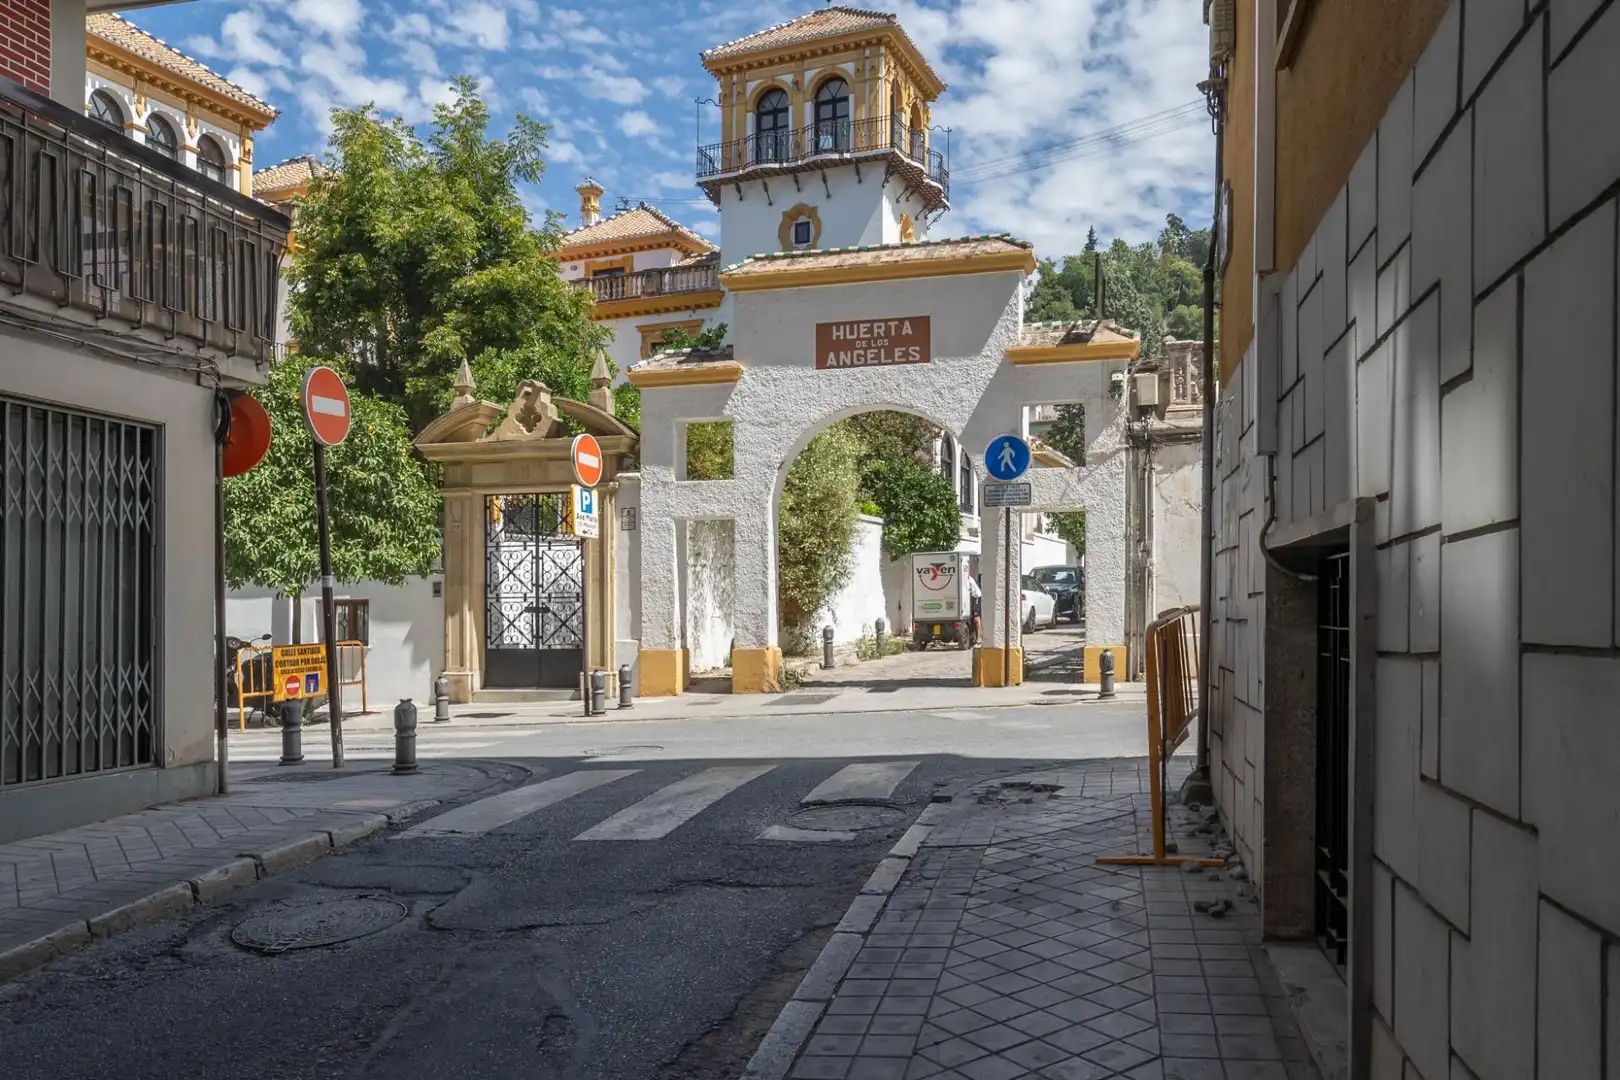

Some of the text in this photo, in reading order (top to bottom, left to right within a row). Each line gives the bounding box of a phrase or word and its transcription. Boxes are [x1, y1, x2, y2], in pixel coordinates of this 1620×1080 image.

[832, 320, 912, 340] HUERTA
[856, 339, 889, 348] DE LOS
[826, 346, 921, 366] ANGELES
[582, 491, 590, 511] P
[281, 648, 297, 657] CALLE
